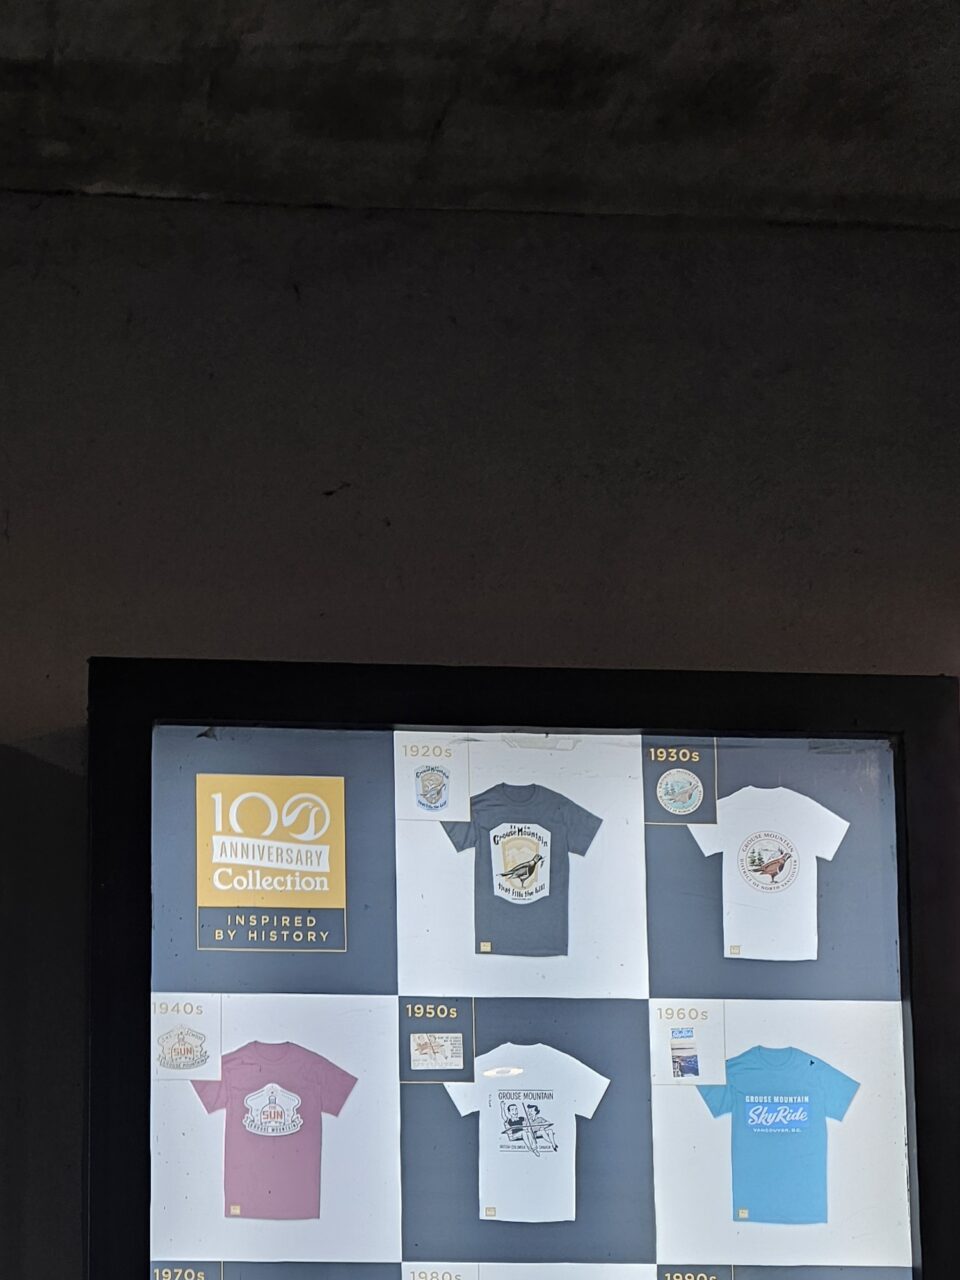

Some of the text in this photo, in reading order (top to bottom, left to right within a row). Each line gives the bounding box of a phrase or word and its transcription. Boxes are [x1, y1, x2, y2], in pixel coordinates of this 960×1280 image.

[402, 745, 452, 758] 1920s
[649, 748, 700, 762] 1930s
[211, 791, 330, 841] 100
[219, 841, 323, 867] ANNIVERSARY
[213, 867, 329, 891] Collection
[227, 915, 316, 927] INSPIRED
[215, 929, 329, 942] BY HISTORY
[152, 1002, 204, 1015] 1940s
[406, 1004, 458, 1018] 1950s
[657, 1007, 709, 1020] 1960s
[498, 1092, 521, 1100] GROUSE
[523, 1092, 553, 1100] MOUNTAIN
[745, 1095, 809, 1103] GROUSE MOUNTAIN
[262, 1110, 283, 1120] SUN
[748, 1105, 808, 1126] SkyRide
